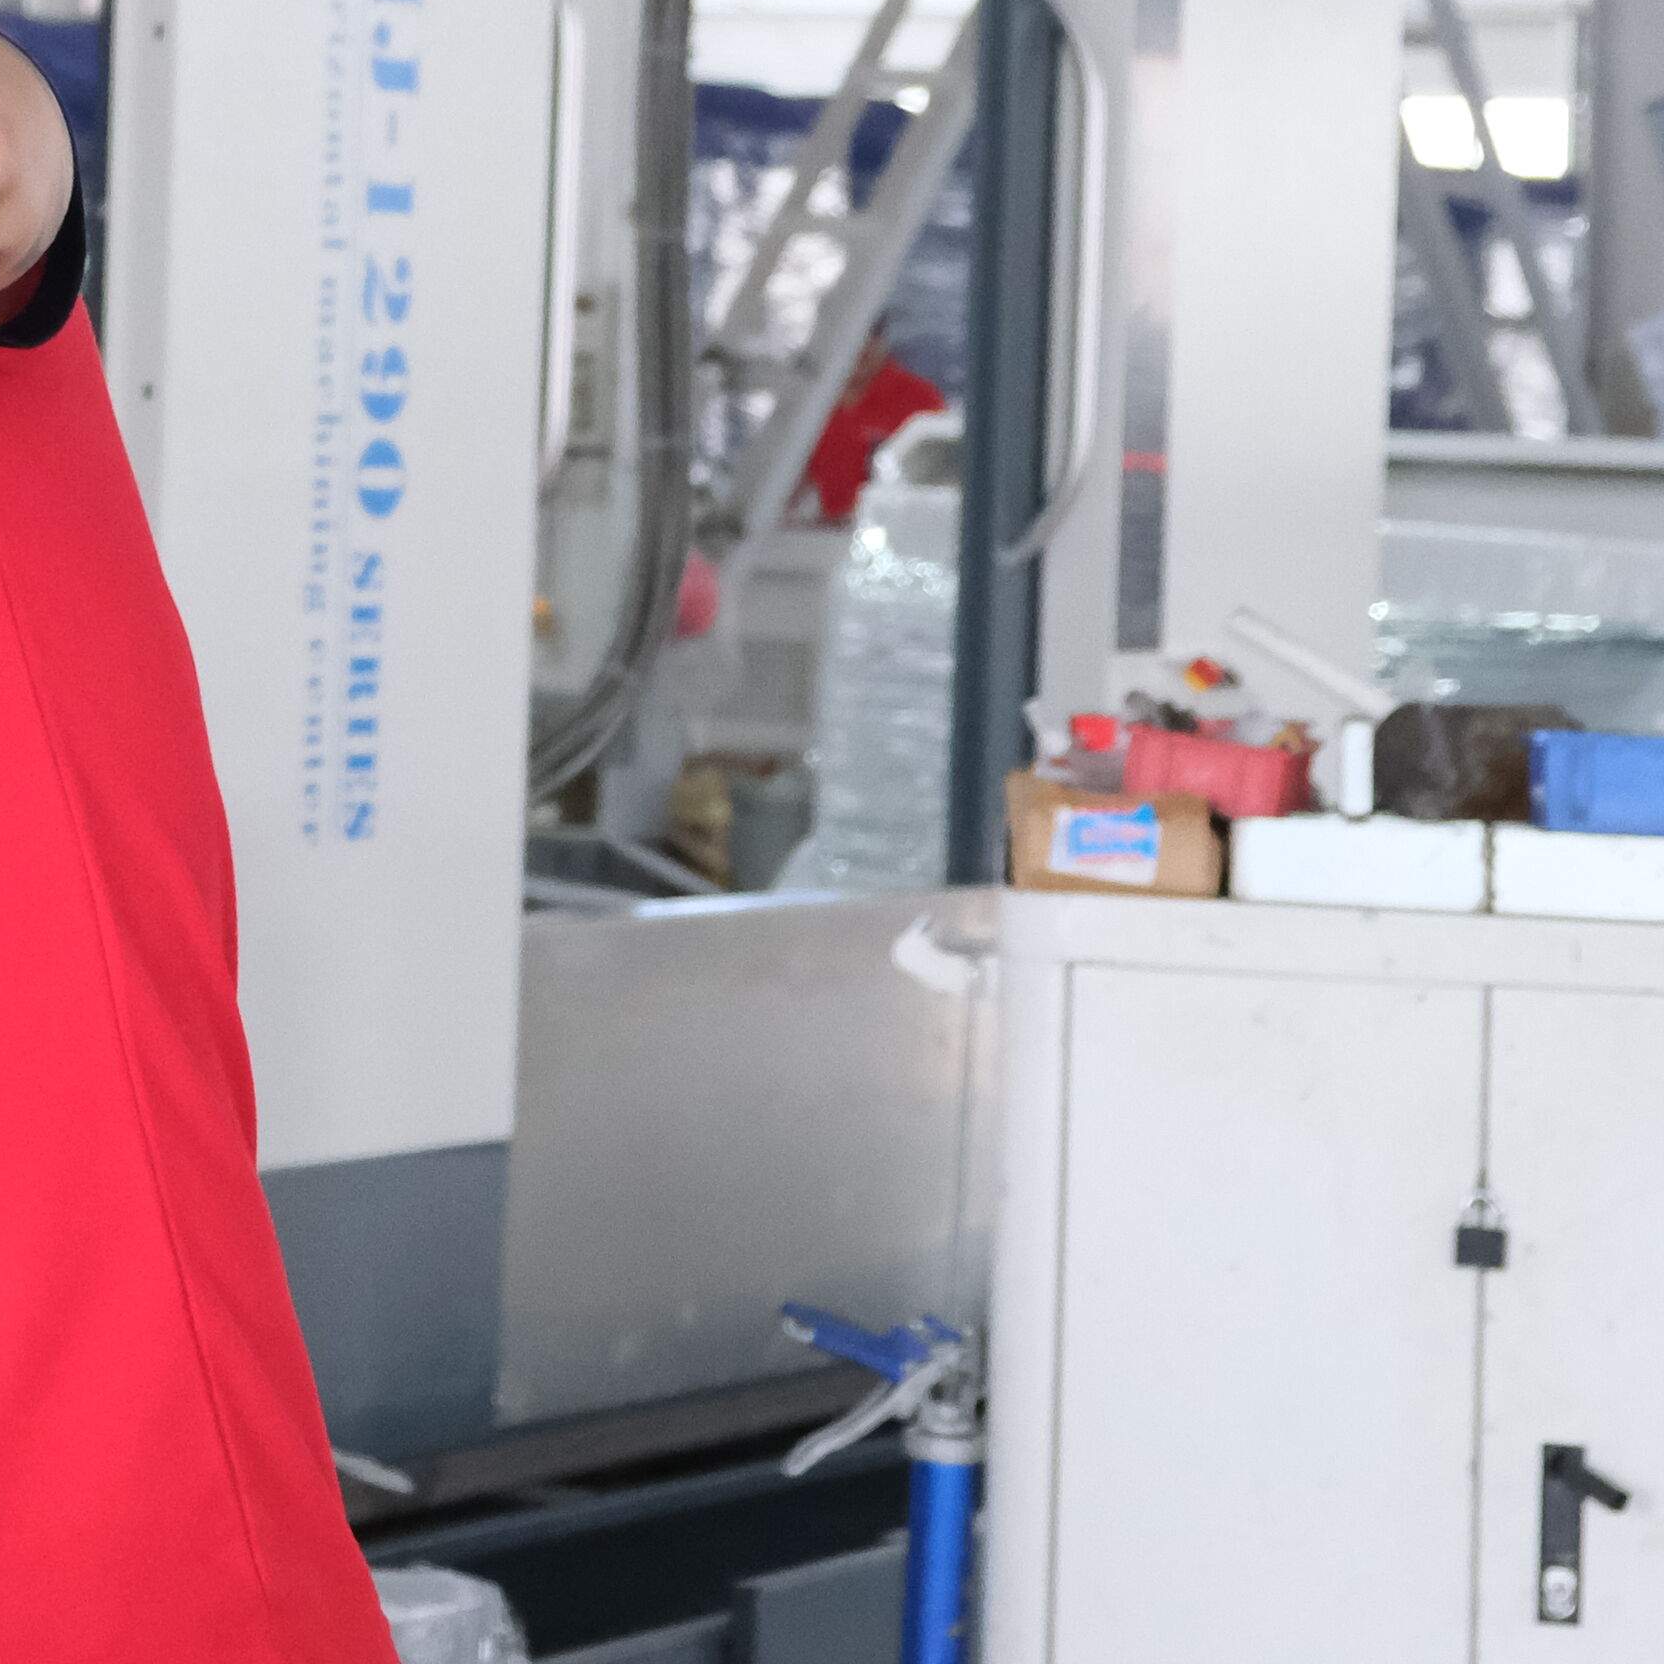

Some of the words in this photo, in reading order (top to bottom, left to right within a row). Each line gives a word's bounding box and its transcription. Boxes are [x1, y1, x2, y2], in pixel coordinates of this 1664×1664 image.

[304, 275, 343, 612] machining
[301, 638, 324, 845] center
[345, 551, 382, 840] SERIES
